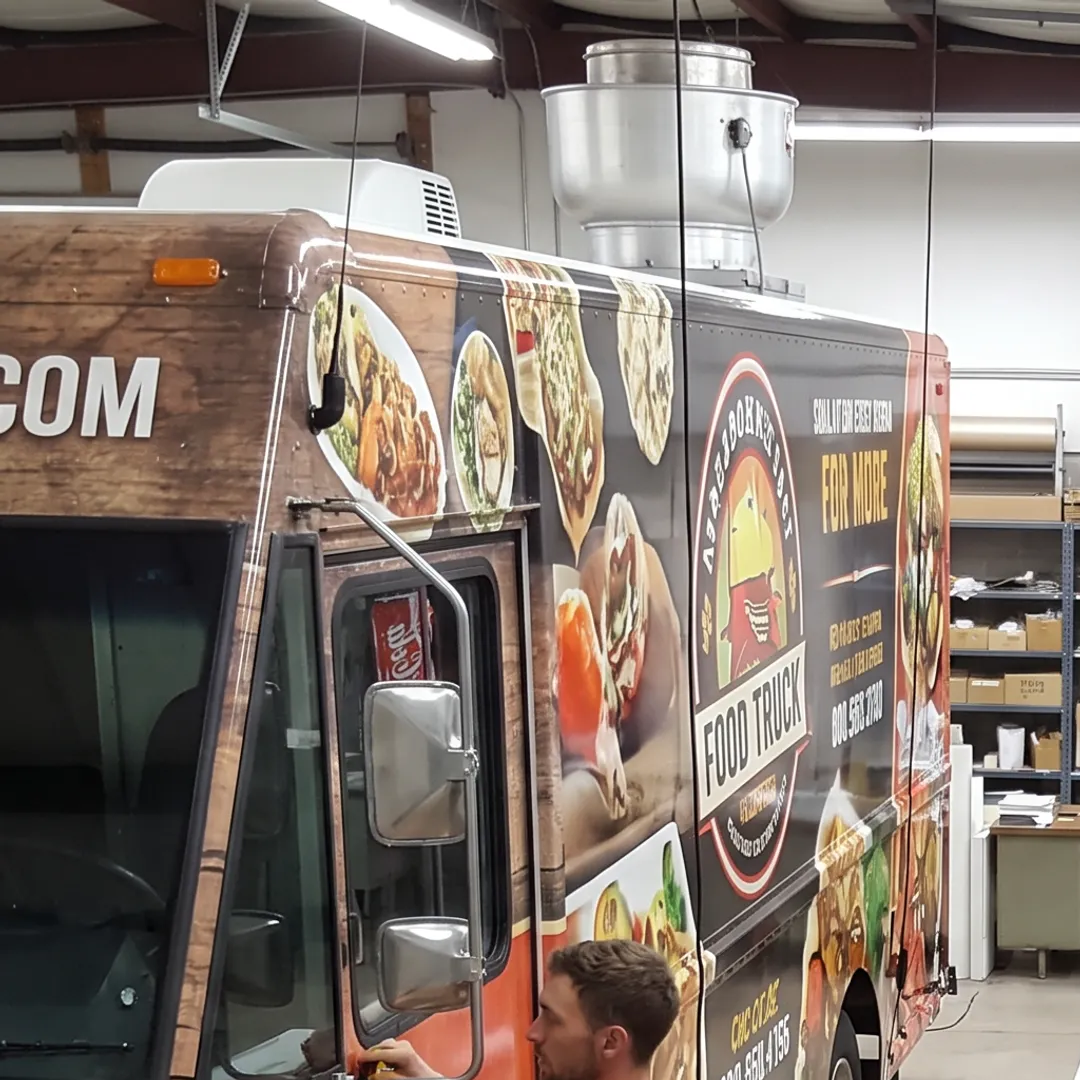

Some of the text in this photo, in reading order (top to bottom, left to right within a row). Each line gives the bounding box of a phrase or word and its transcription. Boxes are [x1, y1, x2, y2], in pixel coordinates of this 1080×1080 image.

[822, 453, 849, 534] FOR
[853, 450, 888, 527] MORE
[704, 699, 749, 797] FOOD
[752, 657, 801, 757] TRUCK
